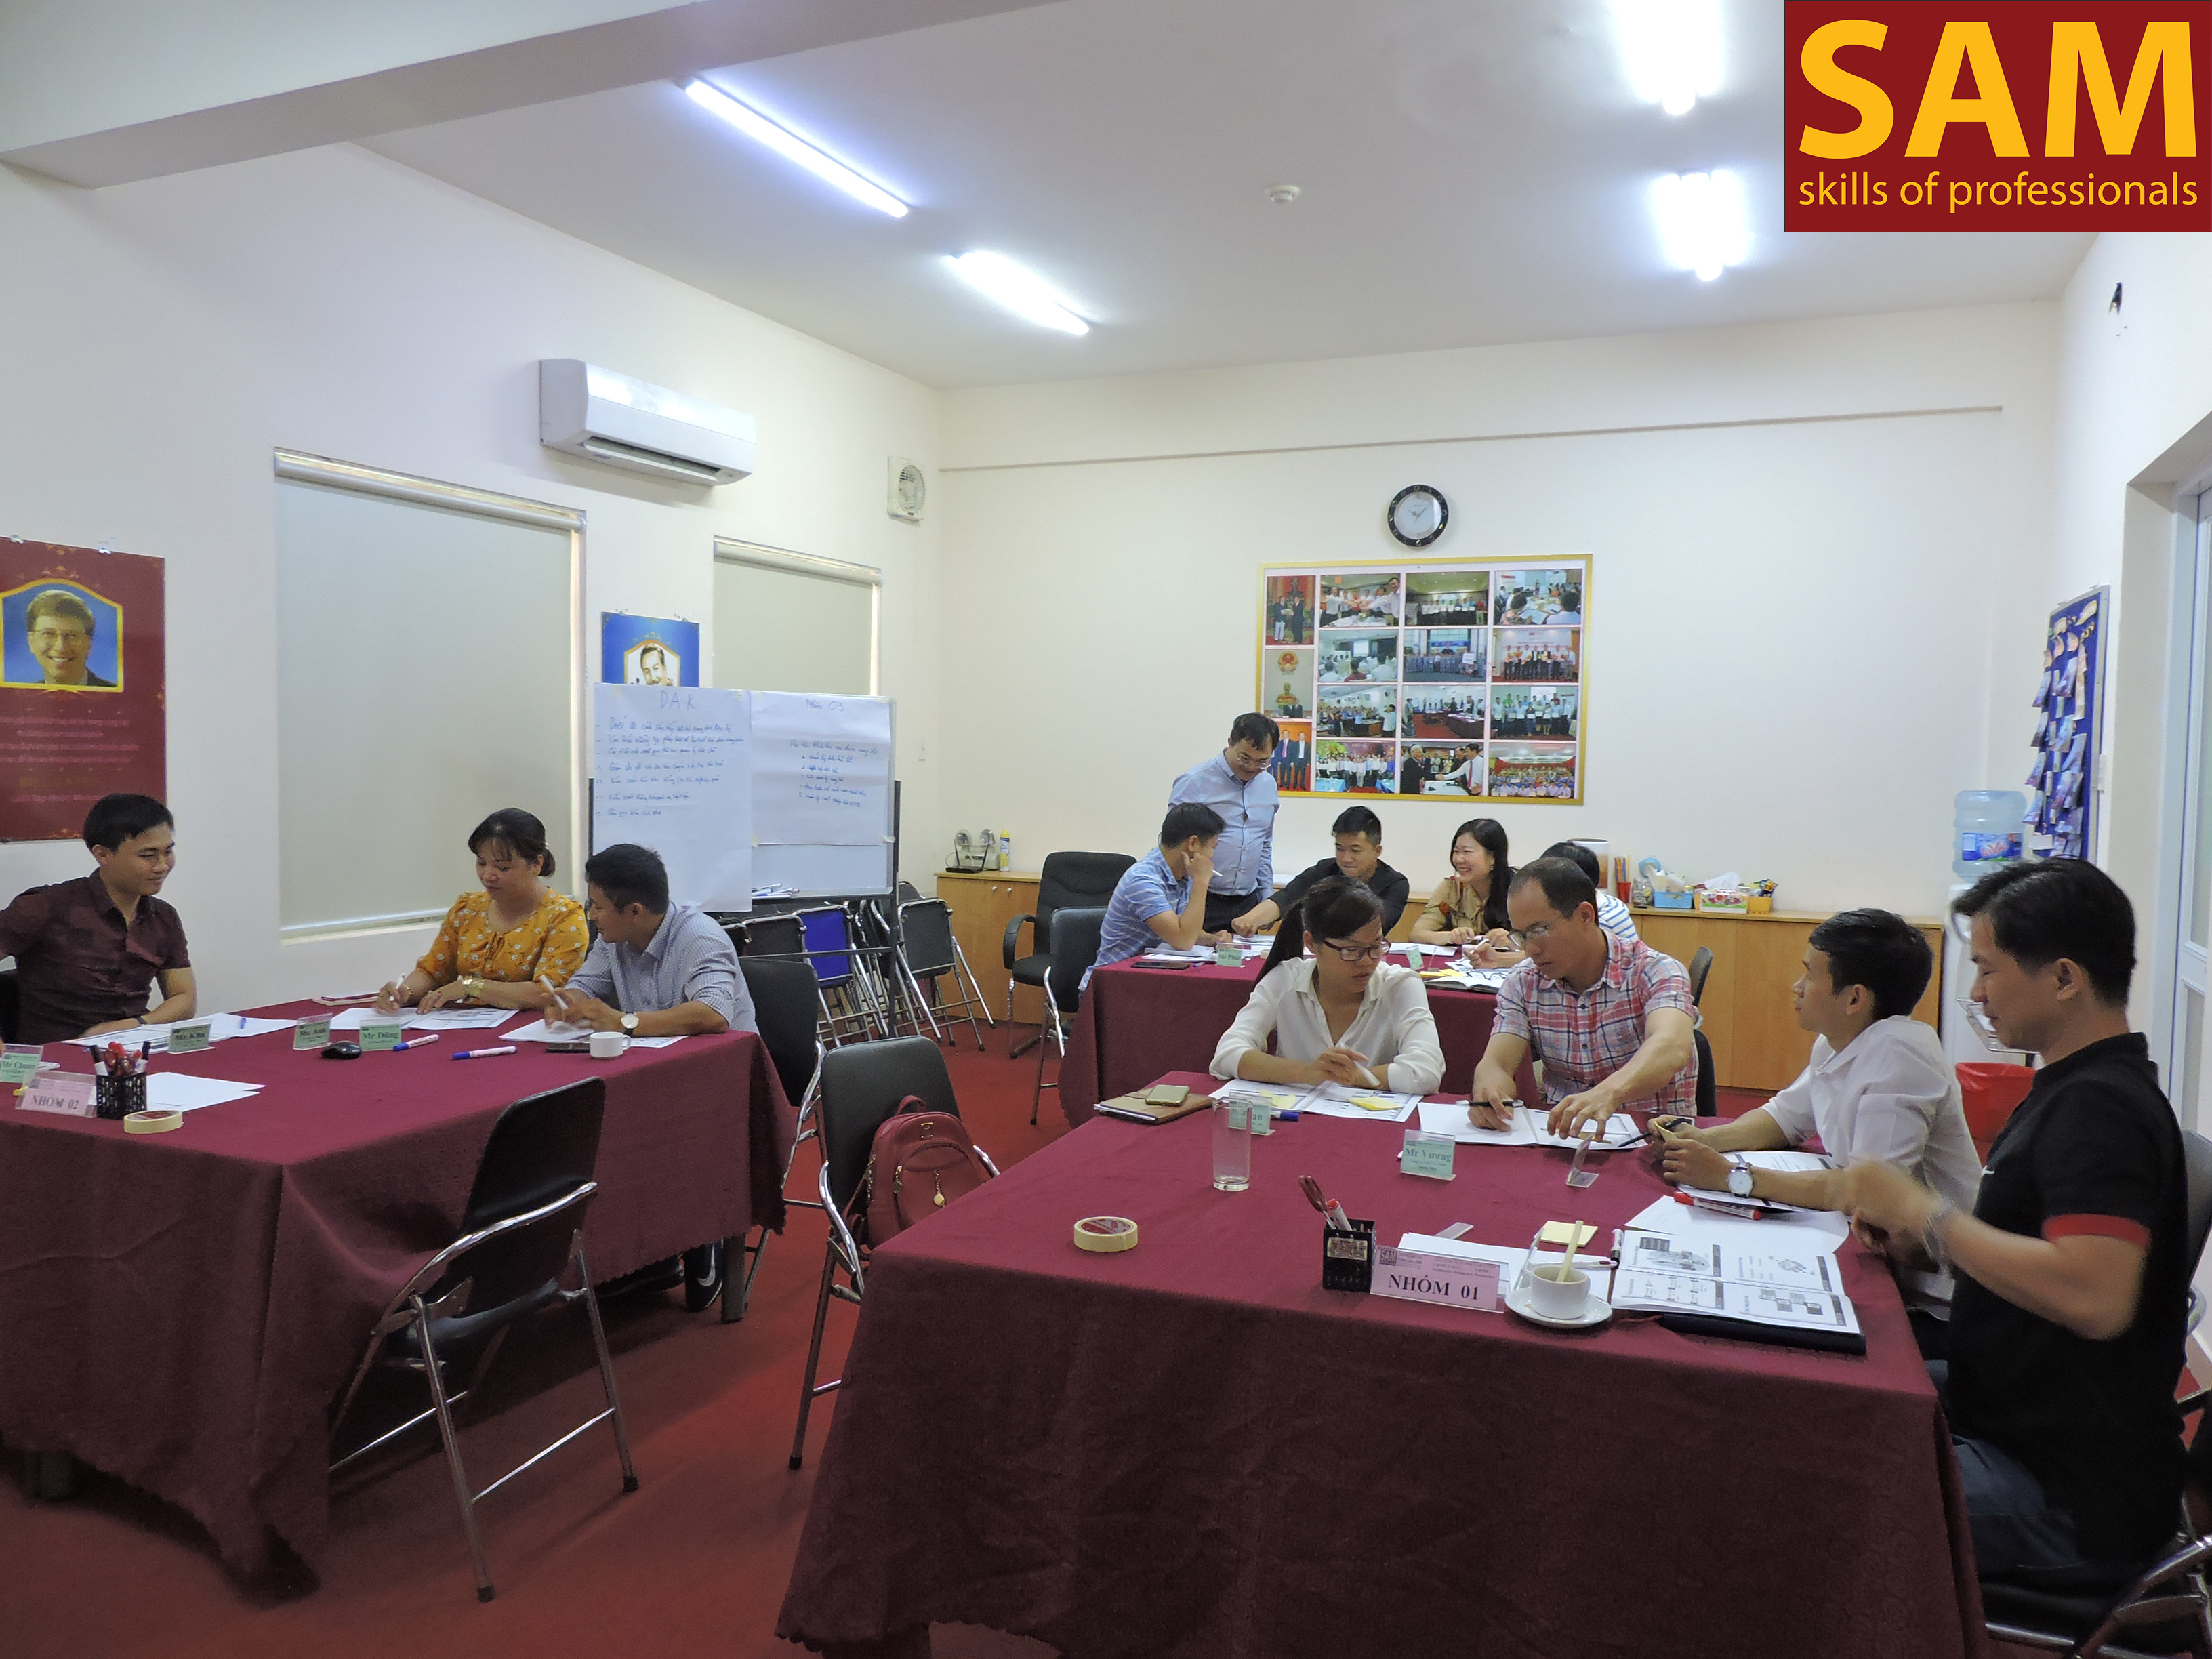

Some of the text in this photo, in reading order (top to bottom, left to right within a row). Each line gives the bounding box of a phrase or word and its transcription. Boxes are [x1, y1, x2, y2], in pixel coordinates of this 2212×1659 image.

[68, 1099, 79, 1109] 02
[1405, 1148, 1420, 1158] Mr
[1389, 1274, 1478, 1300] NHÓM 01
